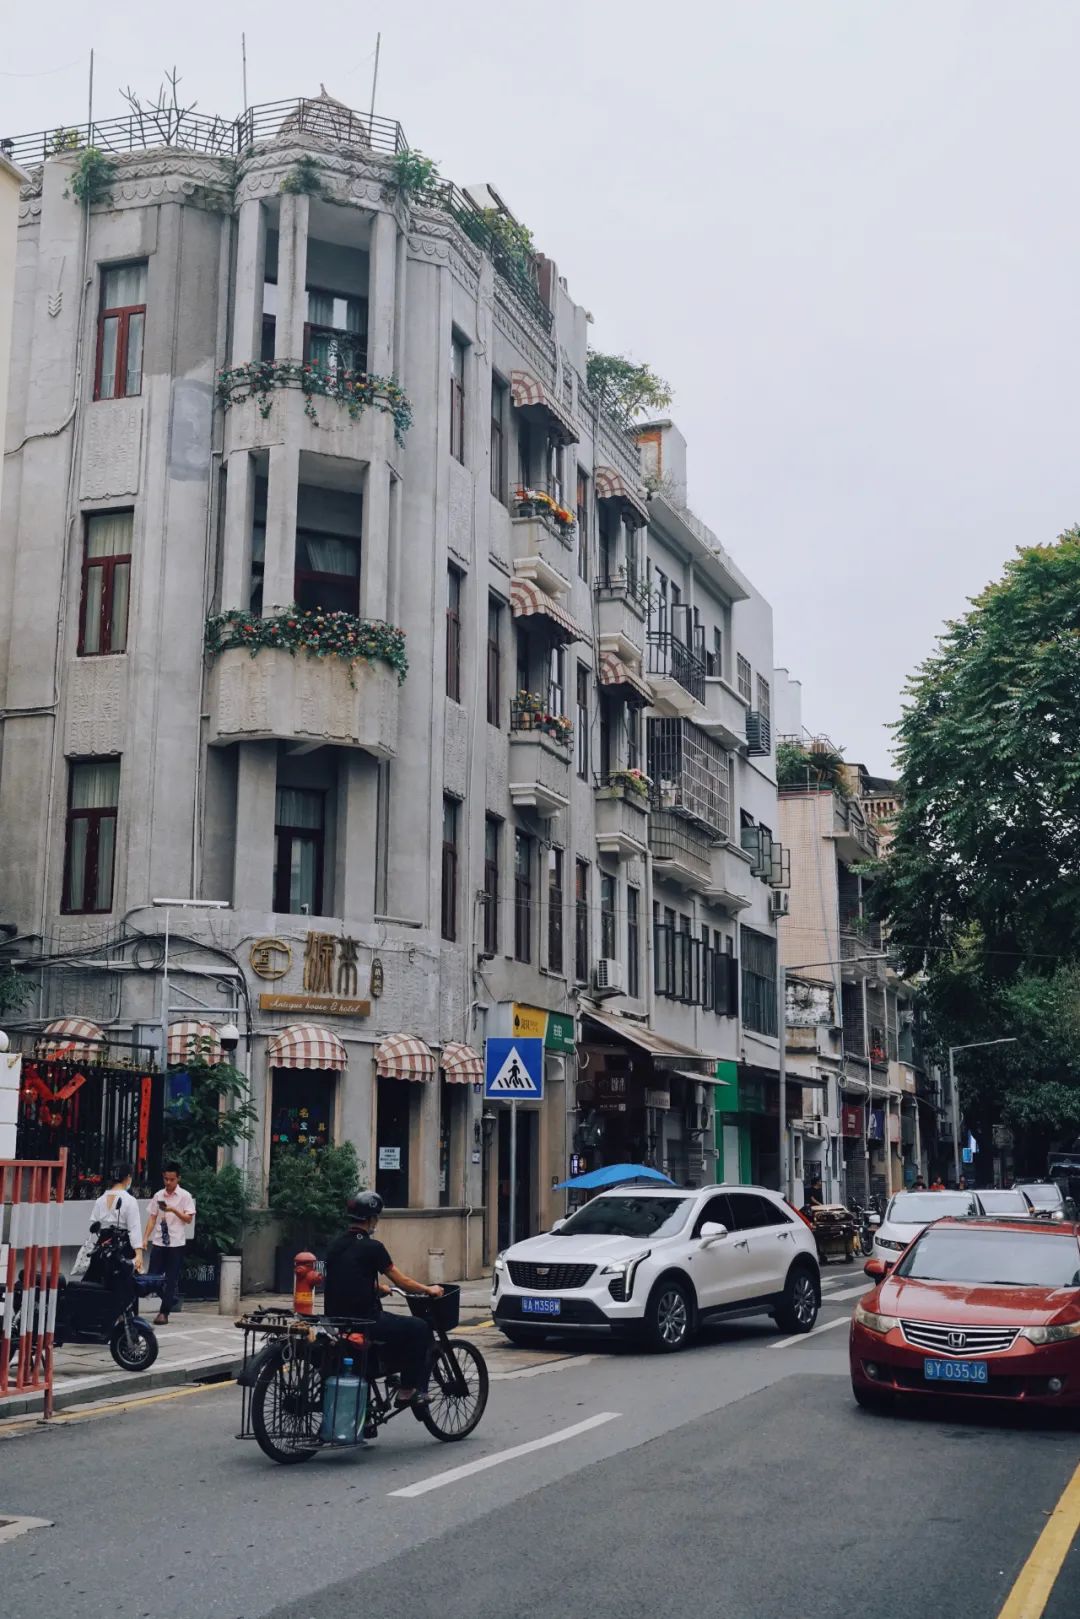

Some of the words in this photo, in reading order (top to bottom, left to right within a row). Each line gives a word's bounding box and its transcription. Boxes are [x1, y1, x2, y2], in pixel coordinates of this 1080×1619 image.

[305, 1001, 328, 1011] house
[330, 1002, 337, 1011] &
[339, 1003, 361, 1014] hotel
